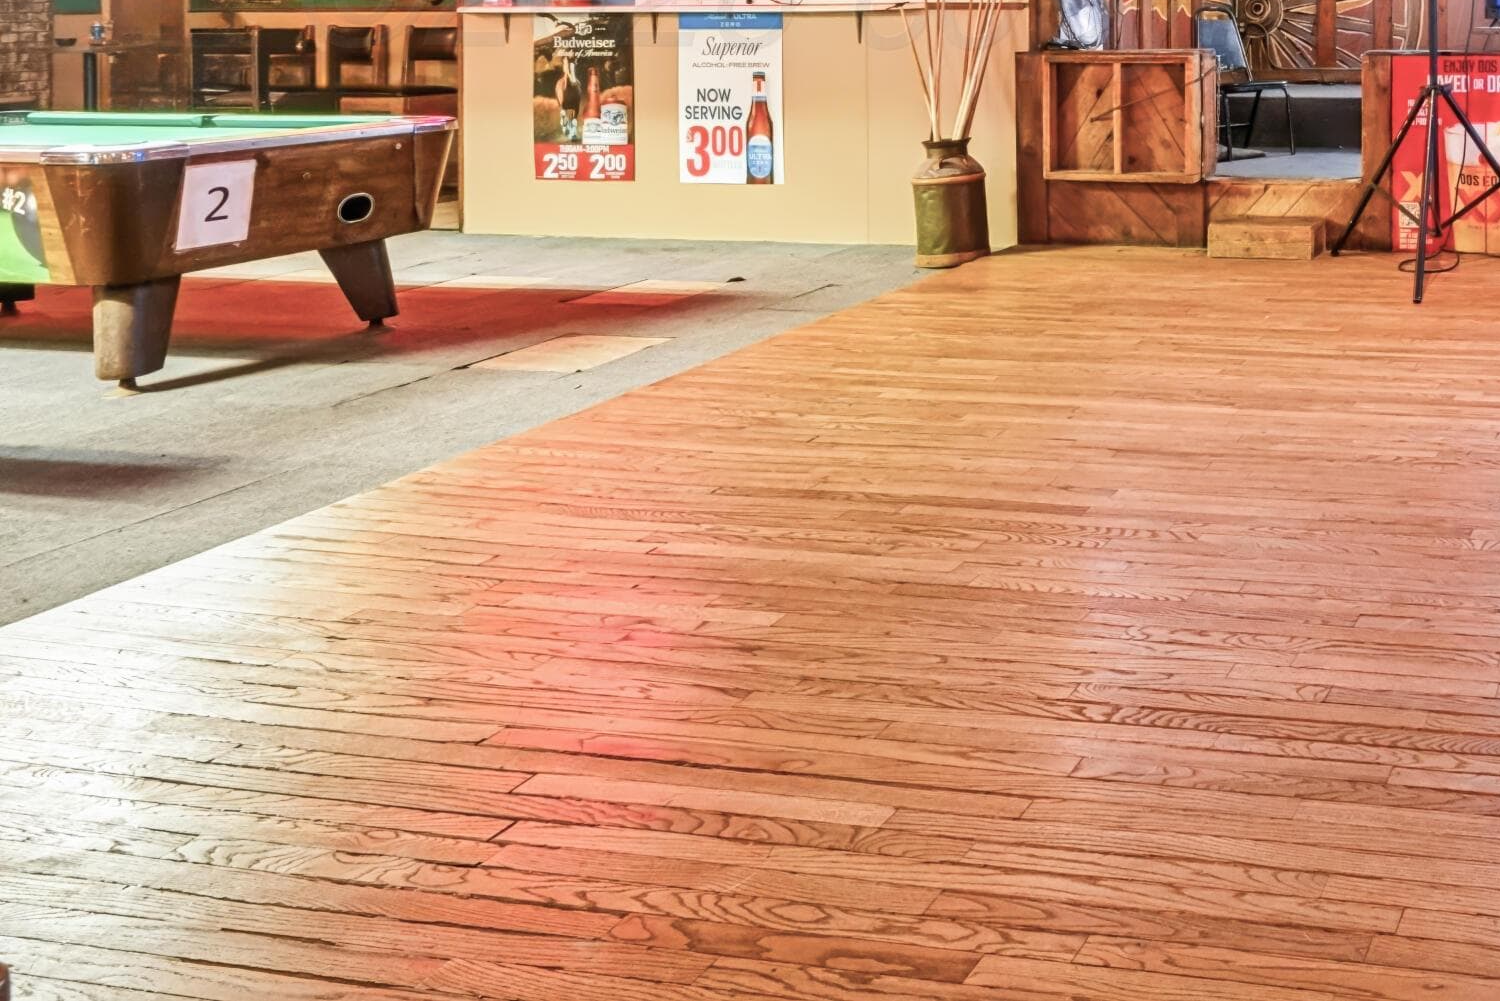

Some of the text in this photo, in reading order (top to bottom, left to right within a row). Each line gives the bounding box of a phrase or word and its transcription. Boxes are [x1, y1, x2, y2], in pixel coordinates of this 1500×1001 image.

[702, 36, 763, 61] Superior
[1443, 60, 1476, 73] ENJOY
[1477, 60, 1498, 73] DOS
[1427, 75, 1471, 93] AKED
[1473, 79, 1485, 90] OR
[696, 88, 731, 103] NOW
[685, 106, 743, 120] SERVING
[2, 187, 26, 215] #2
[204, 186, 230, 223] 2
